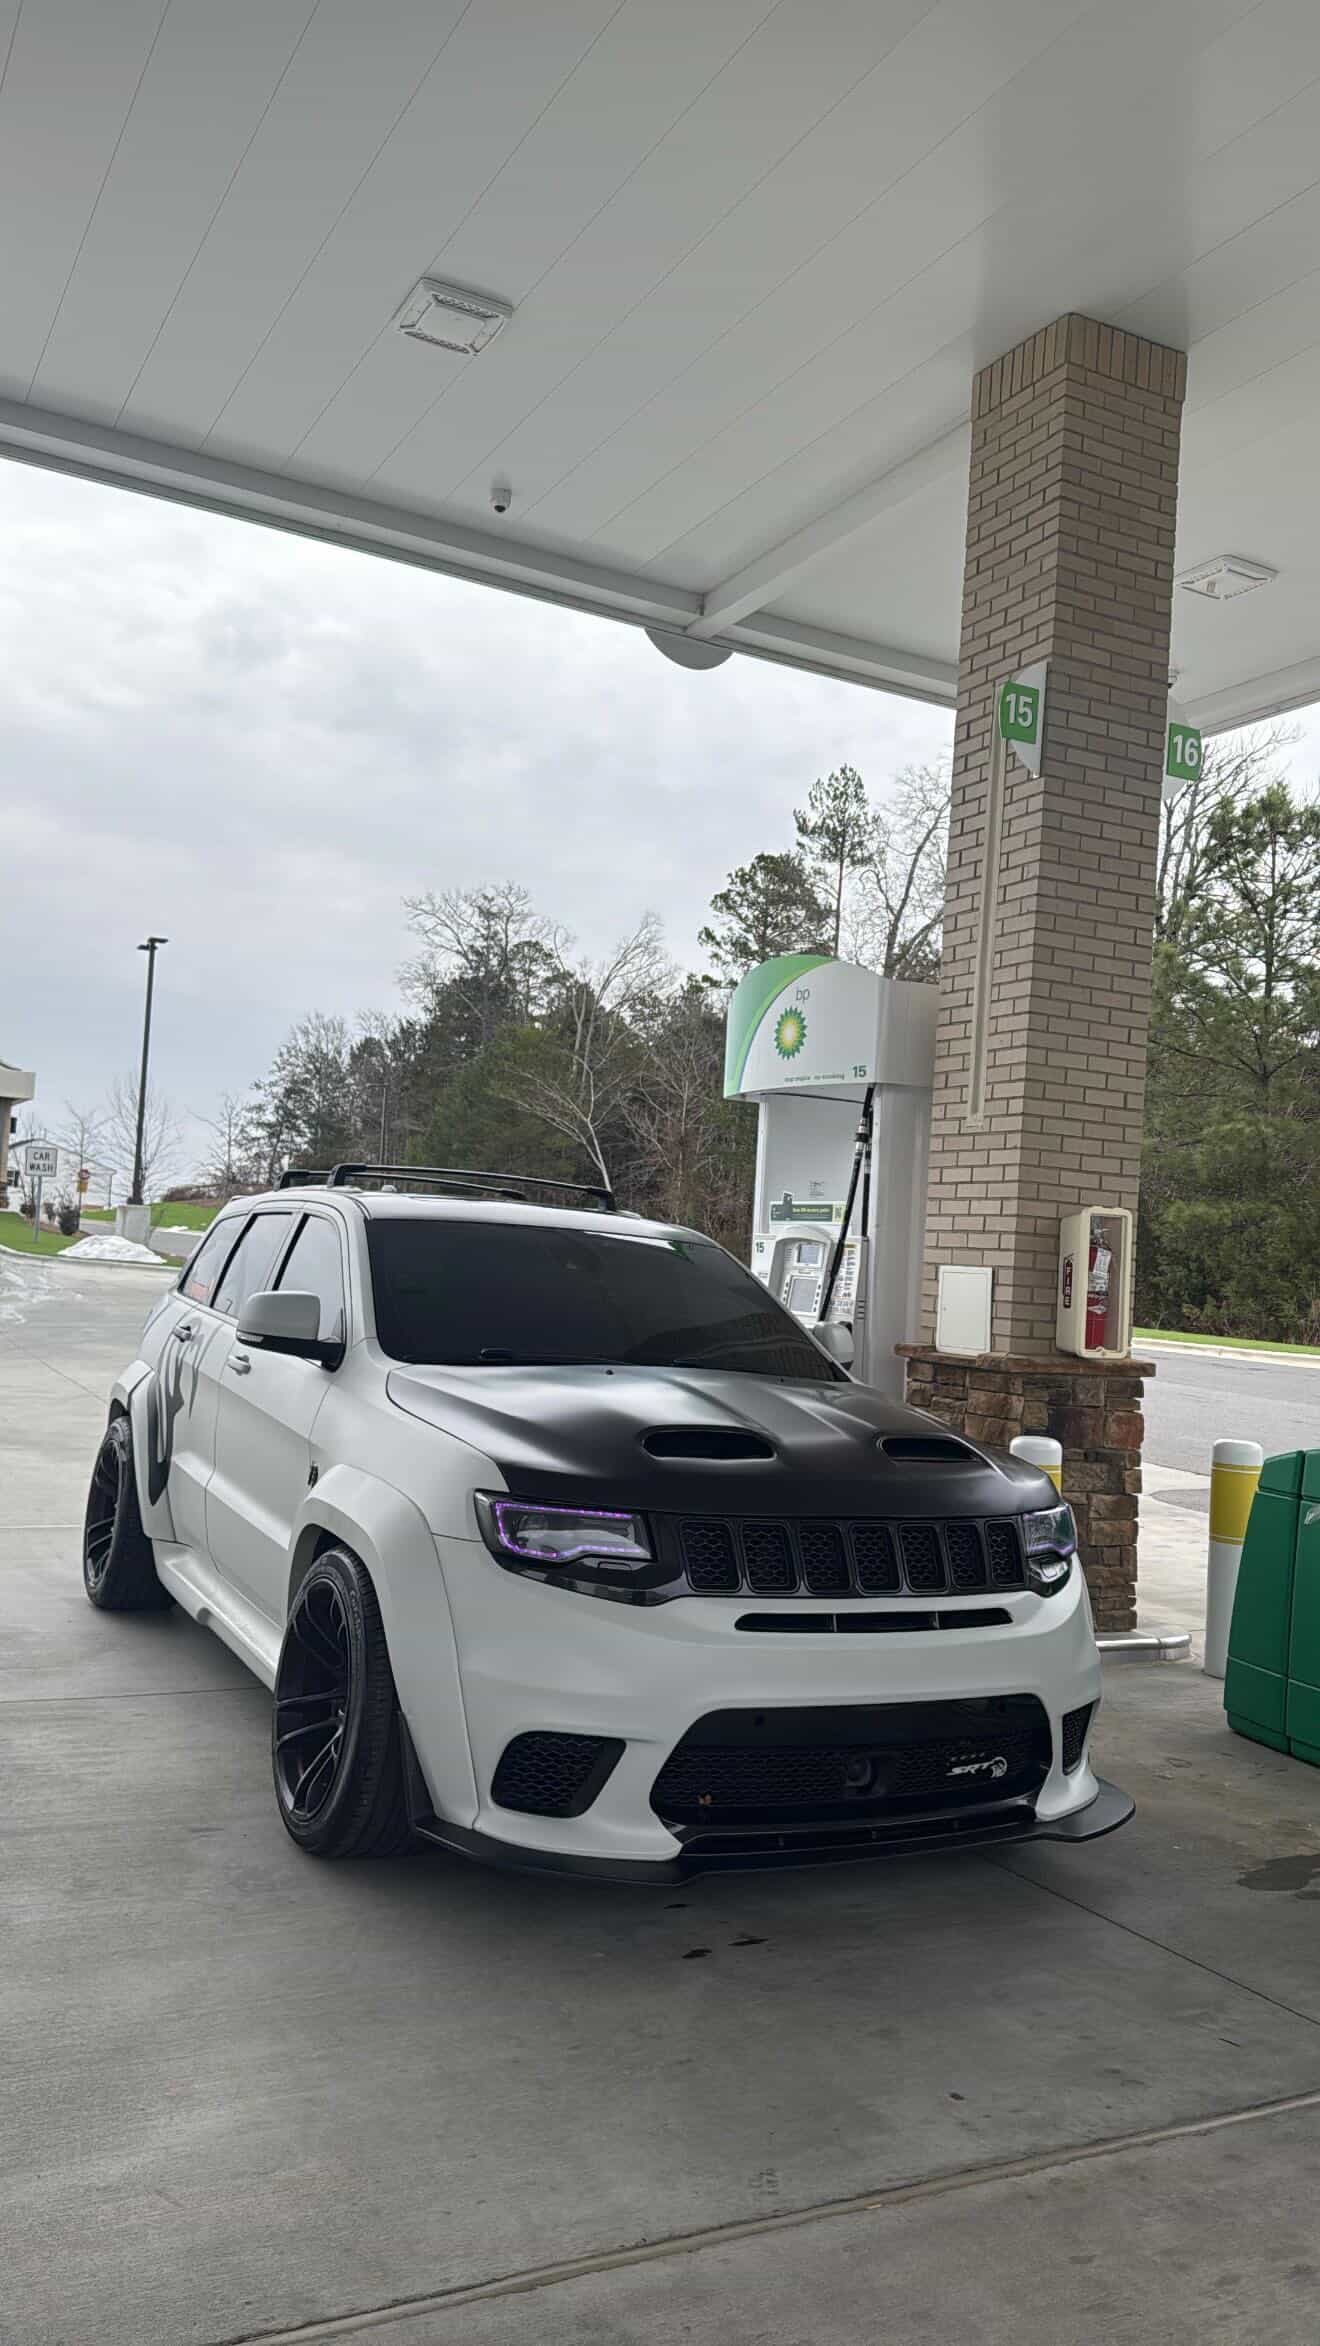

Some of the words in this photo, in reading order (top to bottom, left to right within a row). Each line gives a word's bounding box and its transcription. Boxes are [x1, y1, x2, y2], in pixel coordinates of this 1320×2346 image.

[1006, 693, 1033, 728] 15
[1172, 734, 1199, 766] 16
[796, 986, 810, 1003] bp
[852, 1064, 867, 1078] 15
[33, 1151, 50, 1161] CAR
[29, 1163, 53, 1172] WASH
[756, 1241, 765, 1253] 15
